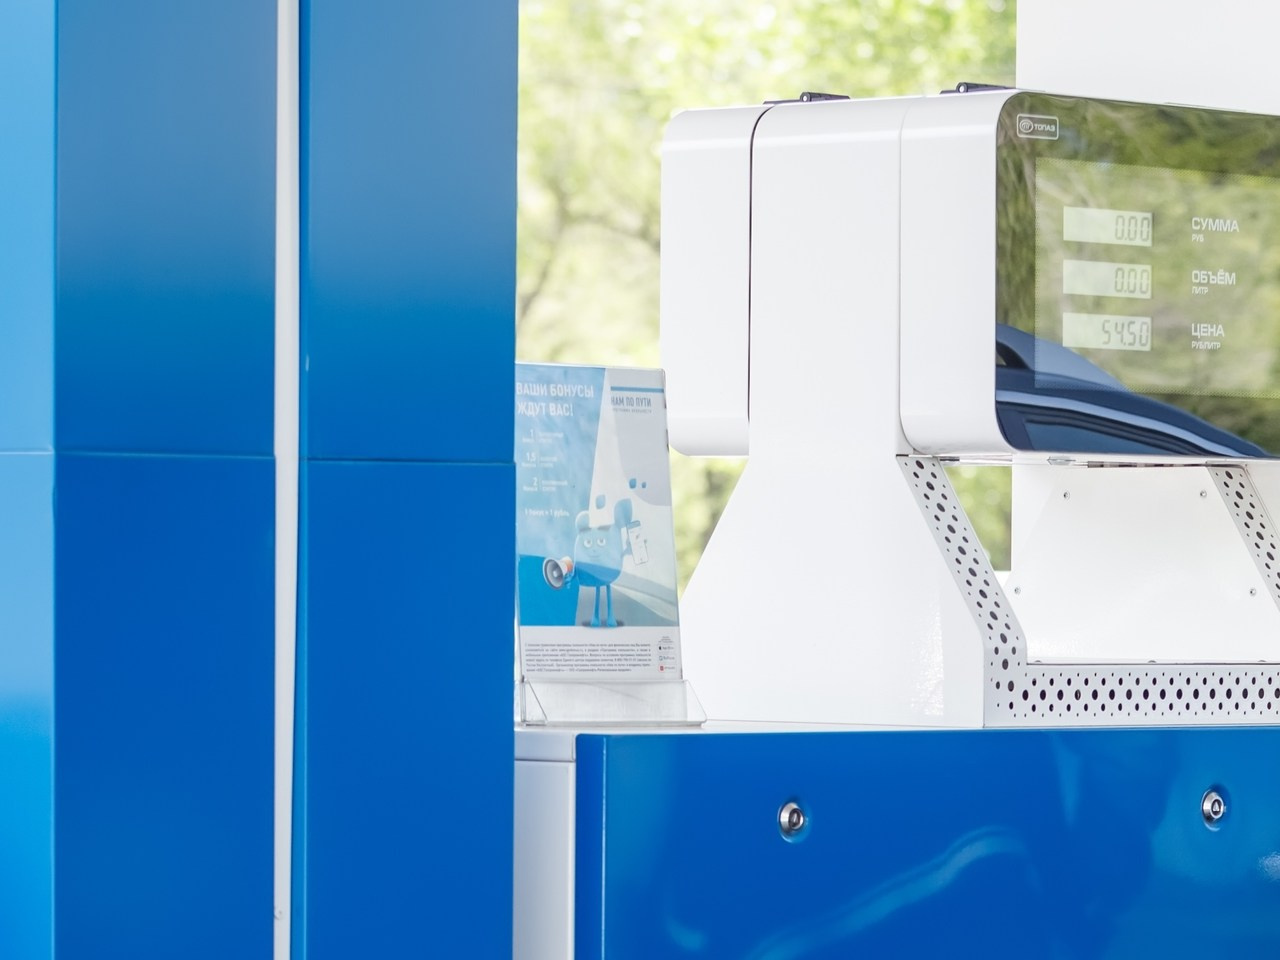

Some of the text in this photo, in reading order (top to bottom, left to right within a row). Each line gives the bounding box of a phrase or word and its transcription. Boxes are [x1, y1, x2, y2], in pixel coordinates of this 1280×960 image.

[1034, 123, 1056, 132] ТОПАЗ
[1115, 215, 1150, 241] 0.00
[1191, 217, 1240, 232] СУММА
[1115, 267, 1150, 294] 0.00
[1191, 269, 1236, 285] ОБЪЁМ
[1102, 319, 1149, 347] 54.50
[1191, 323, 1225, 339] ЦЕНА
[516, 382, 594, 398] ВАШИ БОНУСЫ
[517, 402, 574, 417] ЖДУТ ВАС!
[636, 397, 652, 408] ПУТИ
